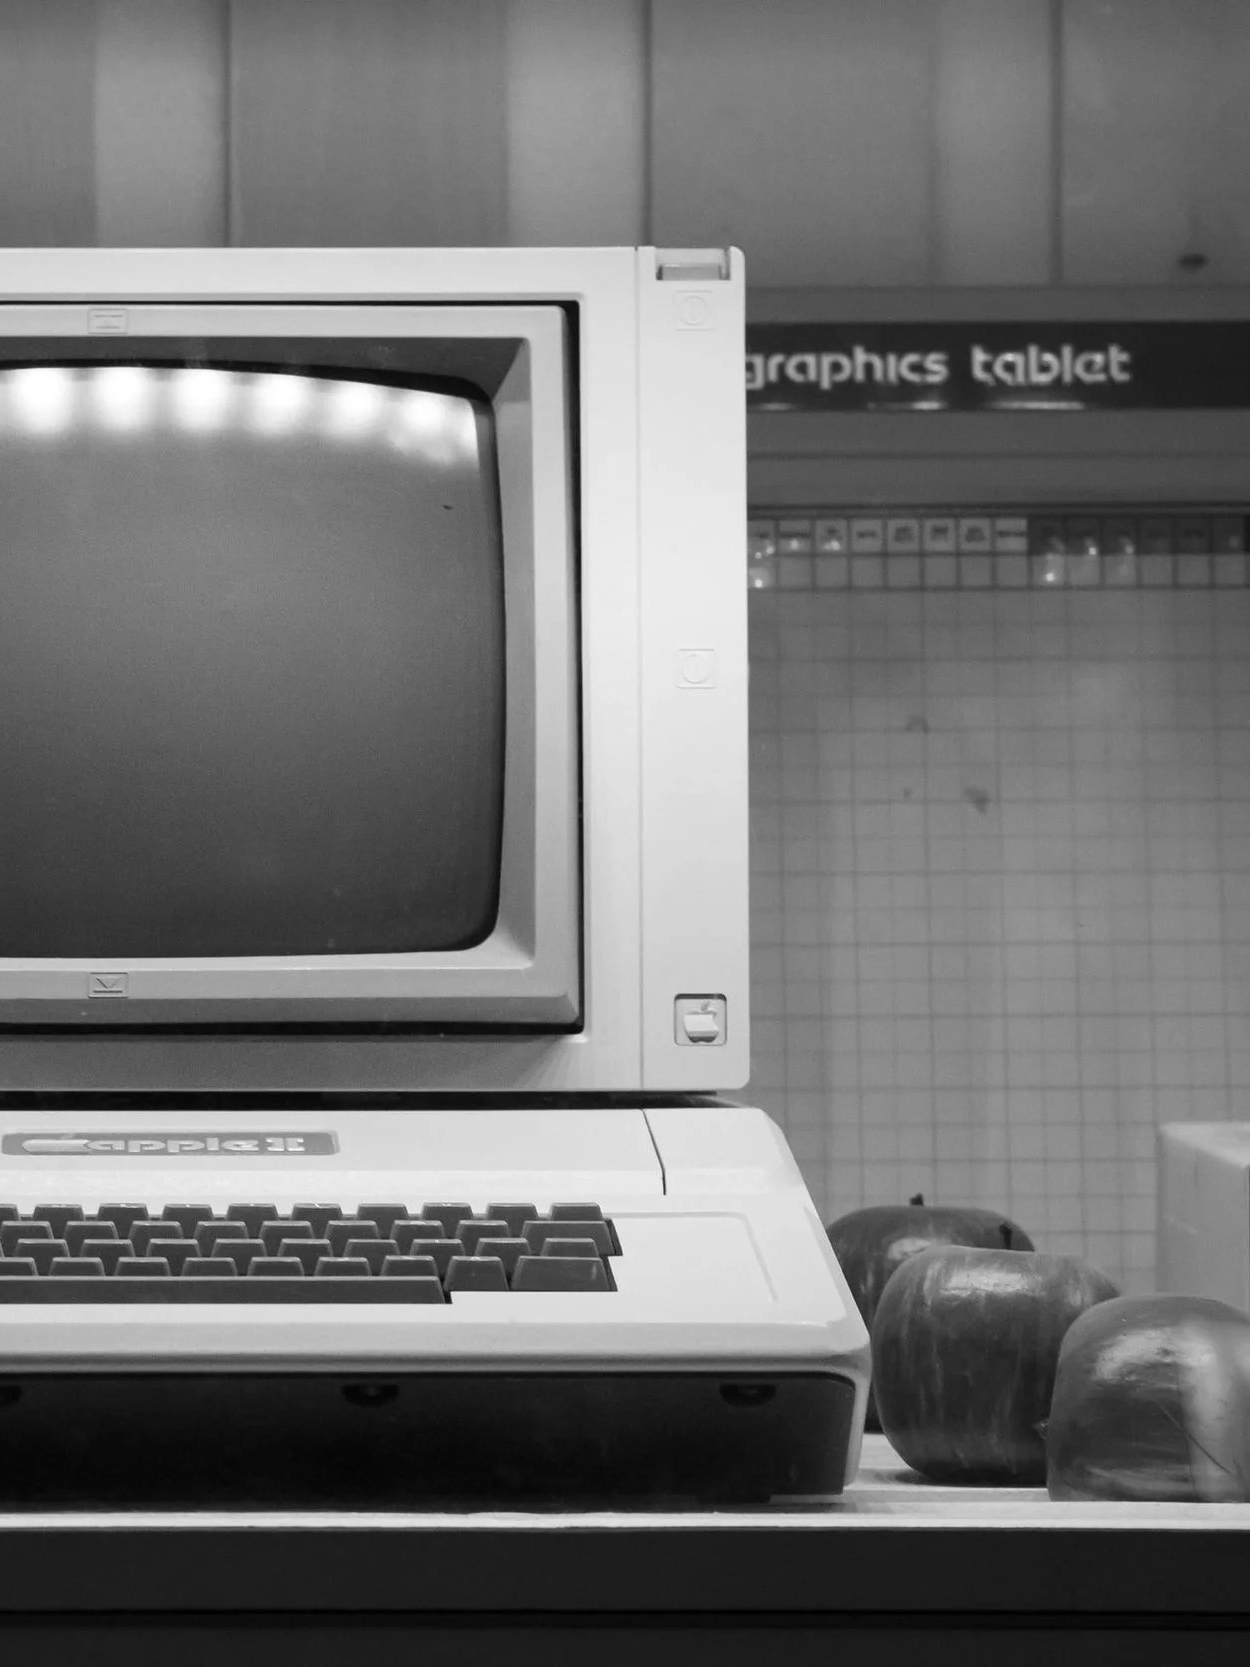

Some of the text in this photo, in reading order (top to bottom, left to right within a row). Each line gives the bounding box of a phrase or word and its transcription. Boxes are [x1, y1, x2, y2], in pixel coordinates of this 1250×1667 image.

[746, 344, 1131, 390] graphics tablet
[88, 1137, 259, 1153] apple
